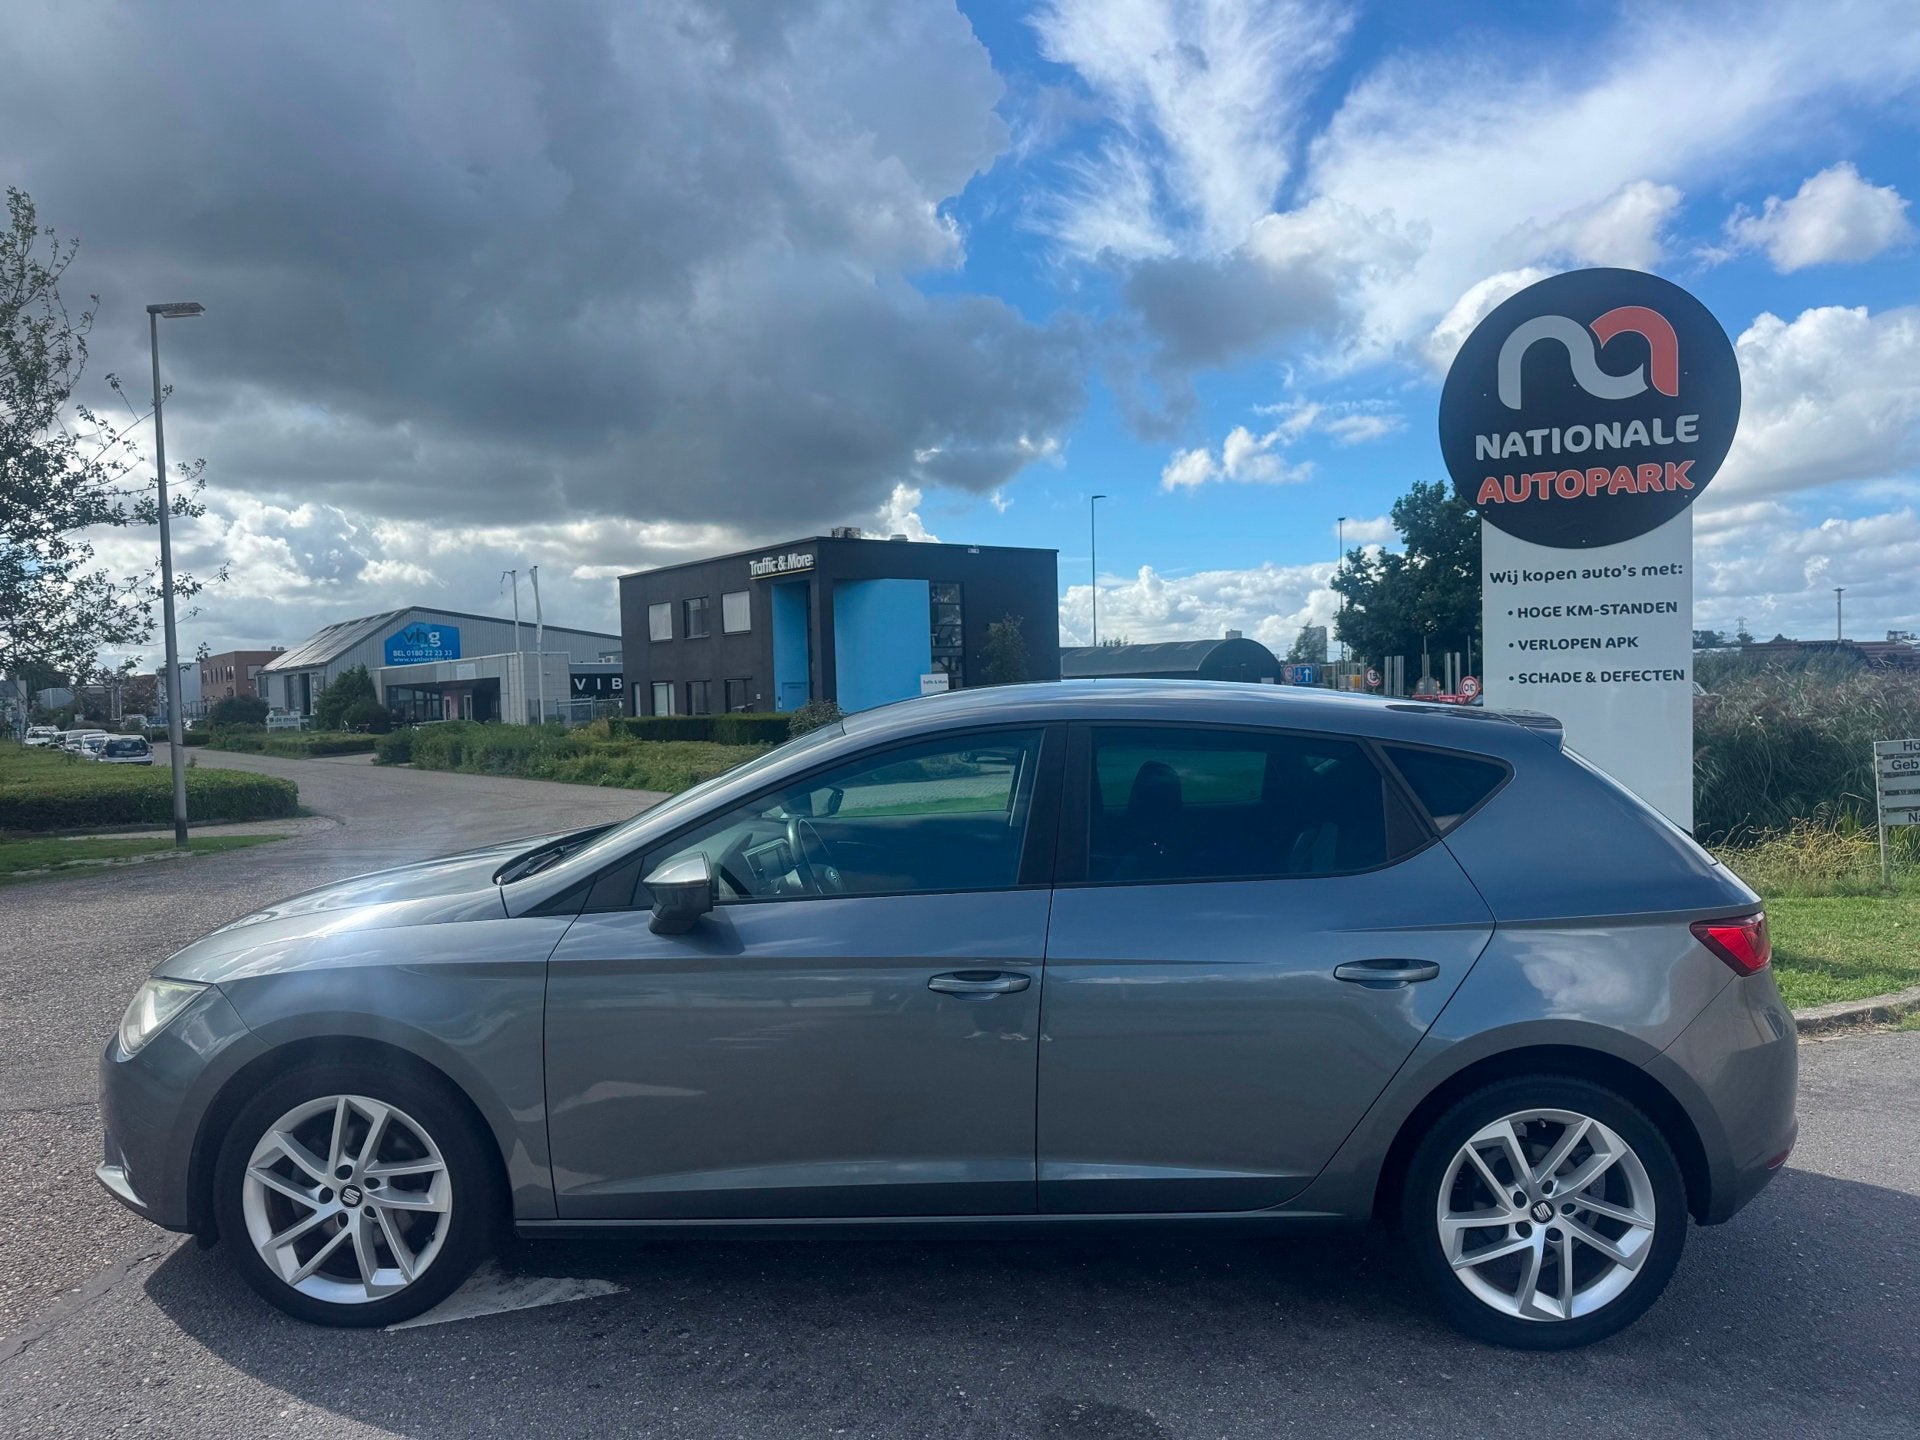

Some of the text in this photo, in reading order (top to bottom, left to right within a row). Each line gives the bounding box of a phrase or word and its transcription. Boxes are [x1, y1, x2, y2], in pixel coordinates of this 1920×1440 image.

[1475, 413, 1700, 461] NATIONALE
[1477, 459, 1695, 505] AUTOPARK
[749, 553, 814, 576] Traffic & More
[1489, 562, 1684, 586] Wij kopen auto's met:
[1517, 601, 1678, 619] HOGE KM-STANDEN
[403, 628, 441, 648] vhg
[1518, 636, 1639, 651] VERLOPEN APK
[1518, 669, 1685, 684] SCHADE & DEFECTEN
[1891, 759, 1919, 771] Geb
